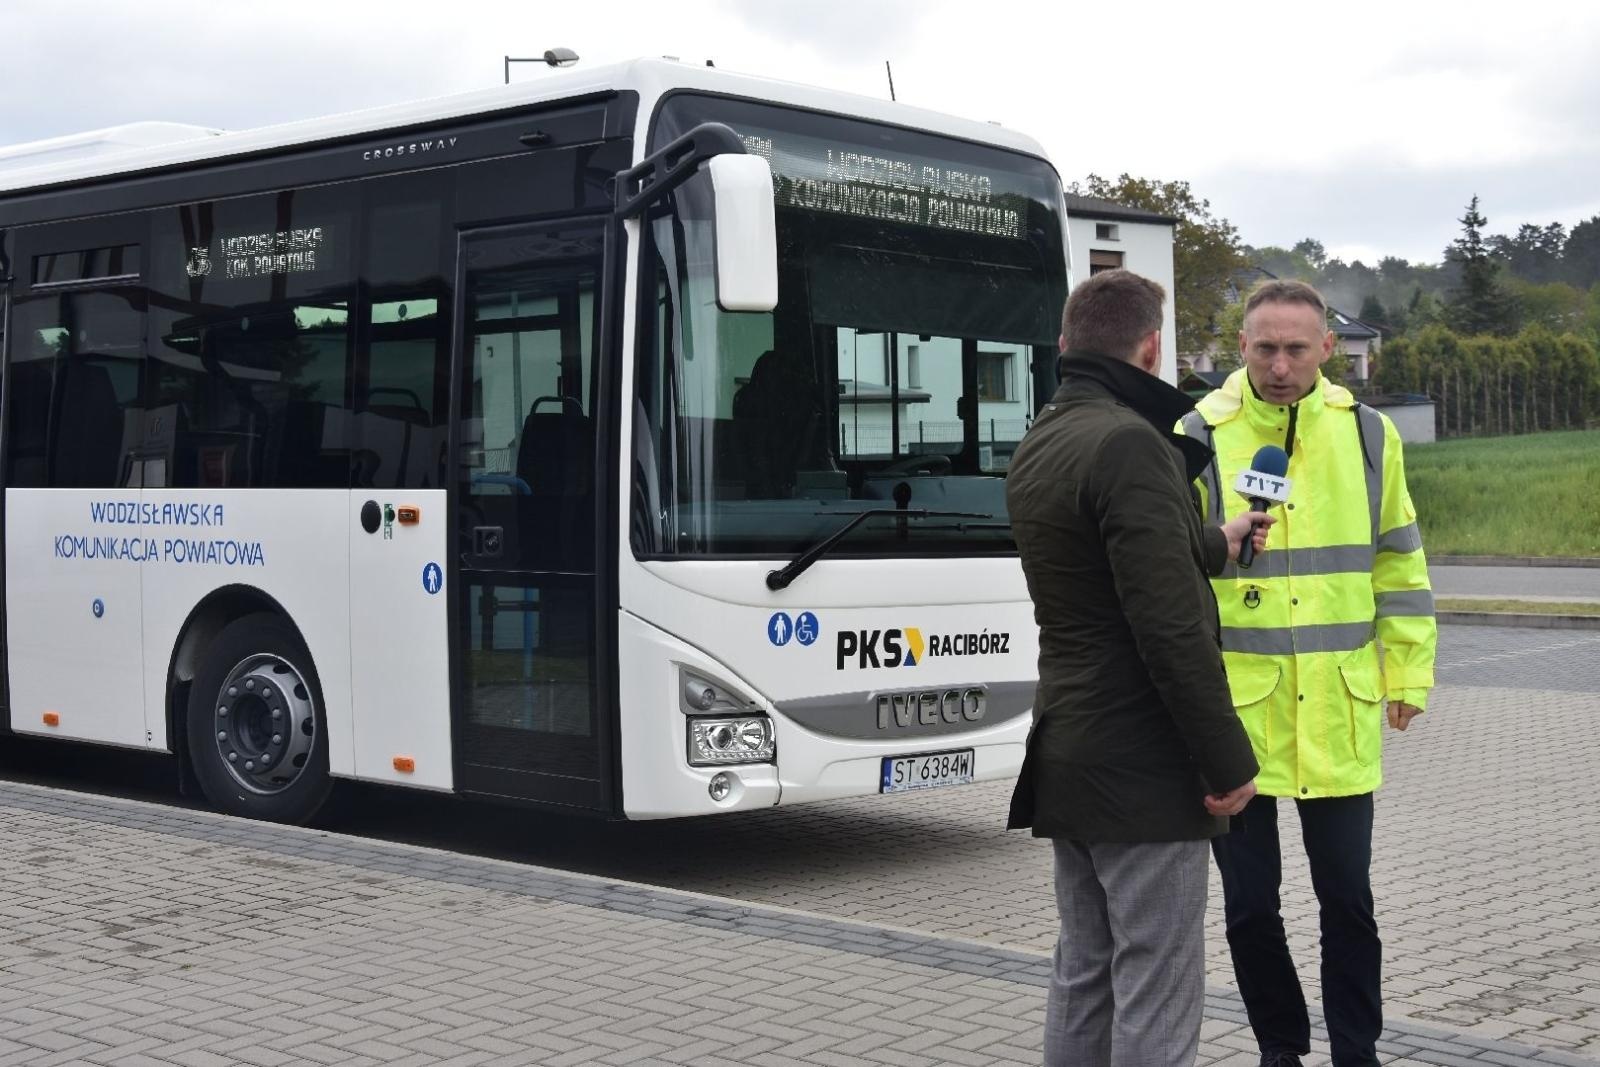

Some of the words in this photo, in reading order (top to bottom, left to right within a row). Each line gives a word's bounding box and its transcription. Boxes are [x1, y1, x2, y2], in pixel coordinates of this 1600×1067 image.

[91, 501, 224, 526] WODZISŁAWSKA
[54, 535, 159, 562] KOMUNIKACJA
[164, 538, 265, 566] POWIATOWA
[836, 628, 902, 670] PKS
[929, 628, 1010, 656] RACIBÓRZ
[876, 687, 987, 729] IVECO
[895, 759, 916, 783] ST
[921, 753, 969, 780] 6384W
